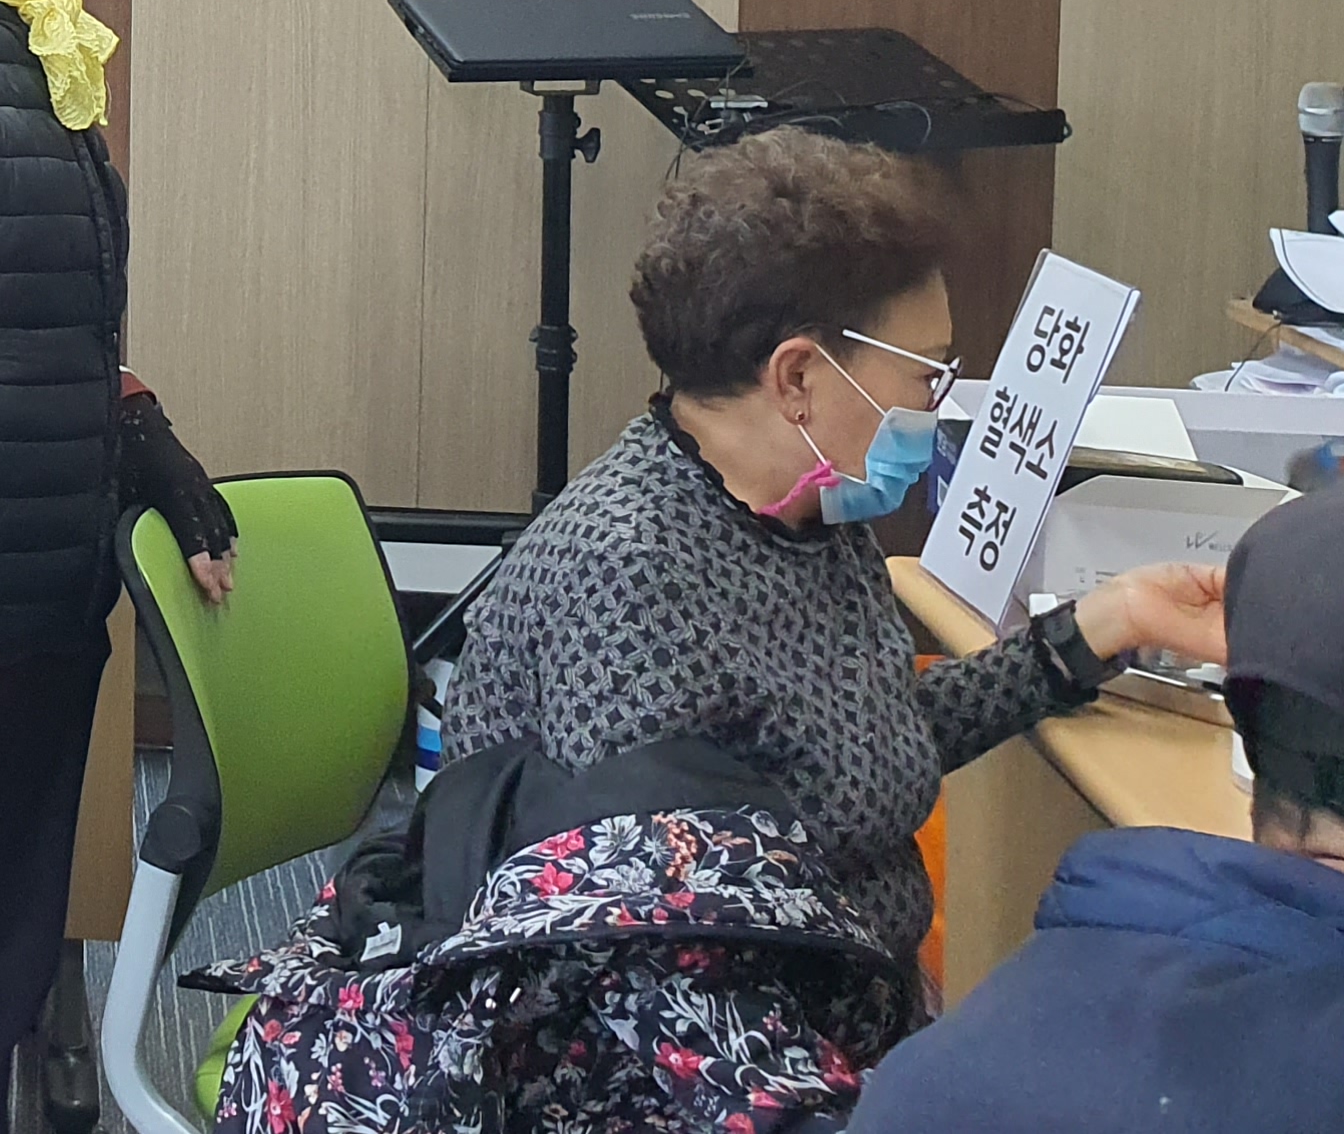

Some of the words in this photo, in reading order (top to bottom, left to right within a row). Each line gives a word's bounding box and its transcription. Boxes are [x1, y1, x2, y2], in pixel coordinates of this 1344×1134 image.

[1025, 304, 1092, 385] 당화
[979, 385, 1058, 482] 혈색소
[958, 484, 1018, 573] 측정
